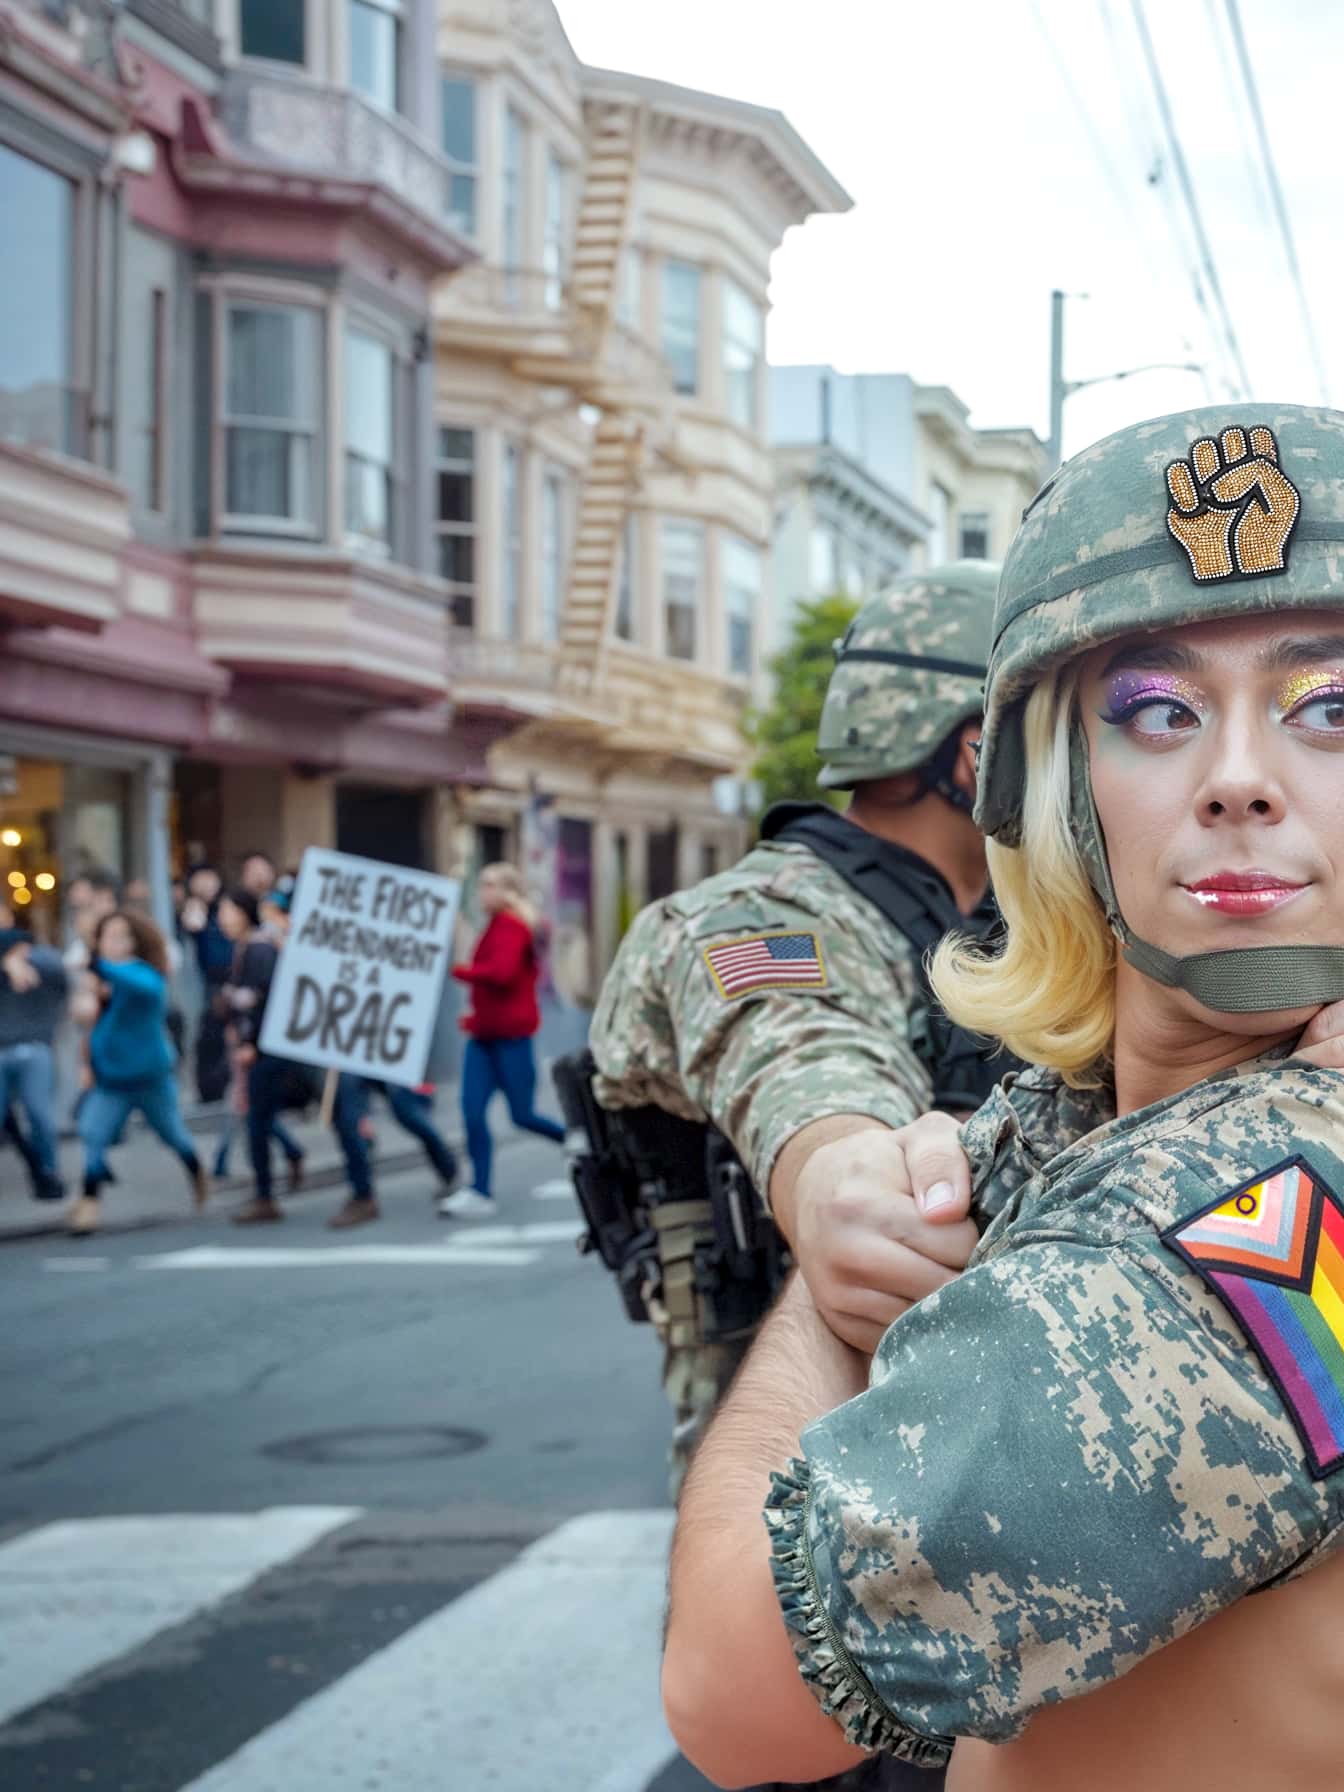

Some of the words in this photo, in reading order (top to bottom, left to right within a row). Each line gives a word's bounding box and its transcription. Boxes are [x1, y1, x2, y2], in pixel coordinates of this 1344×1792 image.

[317, 867, 365, 913] THE
[371, 875, 447, 931] FIRST
[299, 909, 443, 974] AMENDMENT
[338, 960, 359, 982] IS
[365, 965, 381, 986] A
[285, 974, 413, 1065] DRAG
